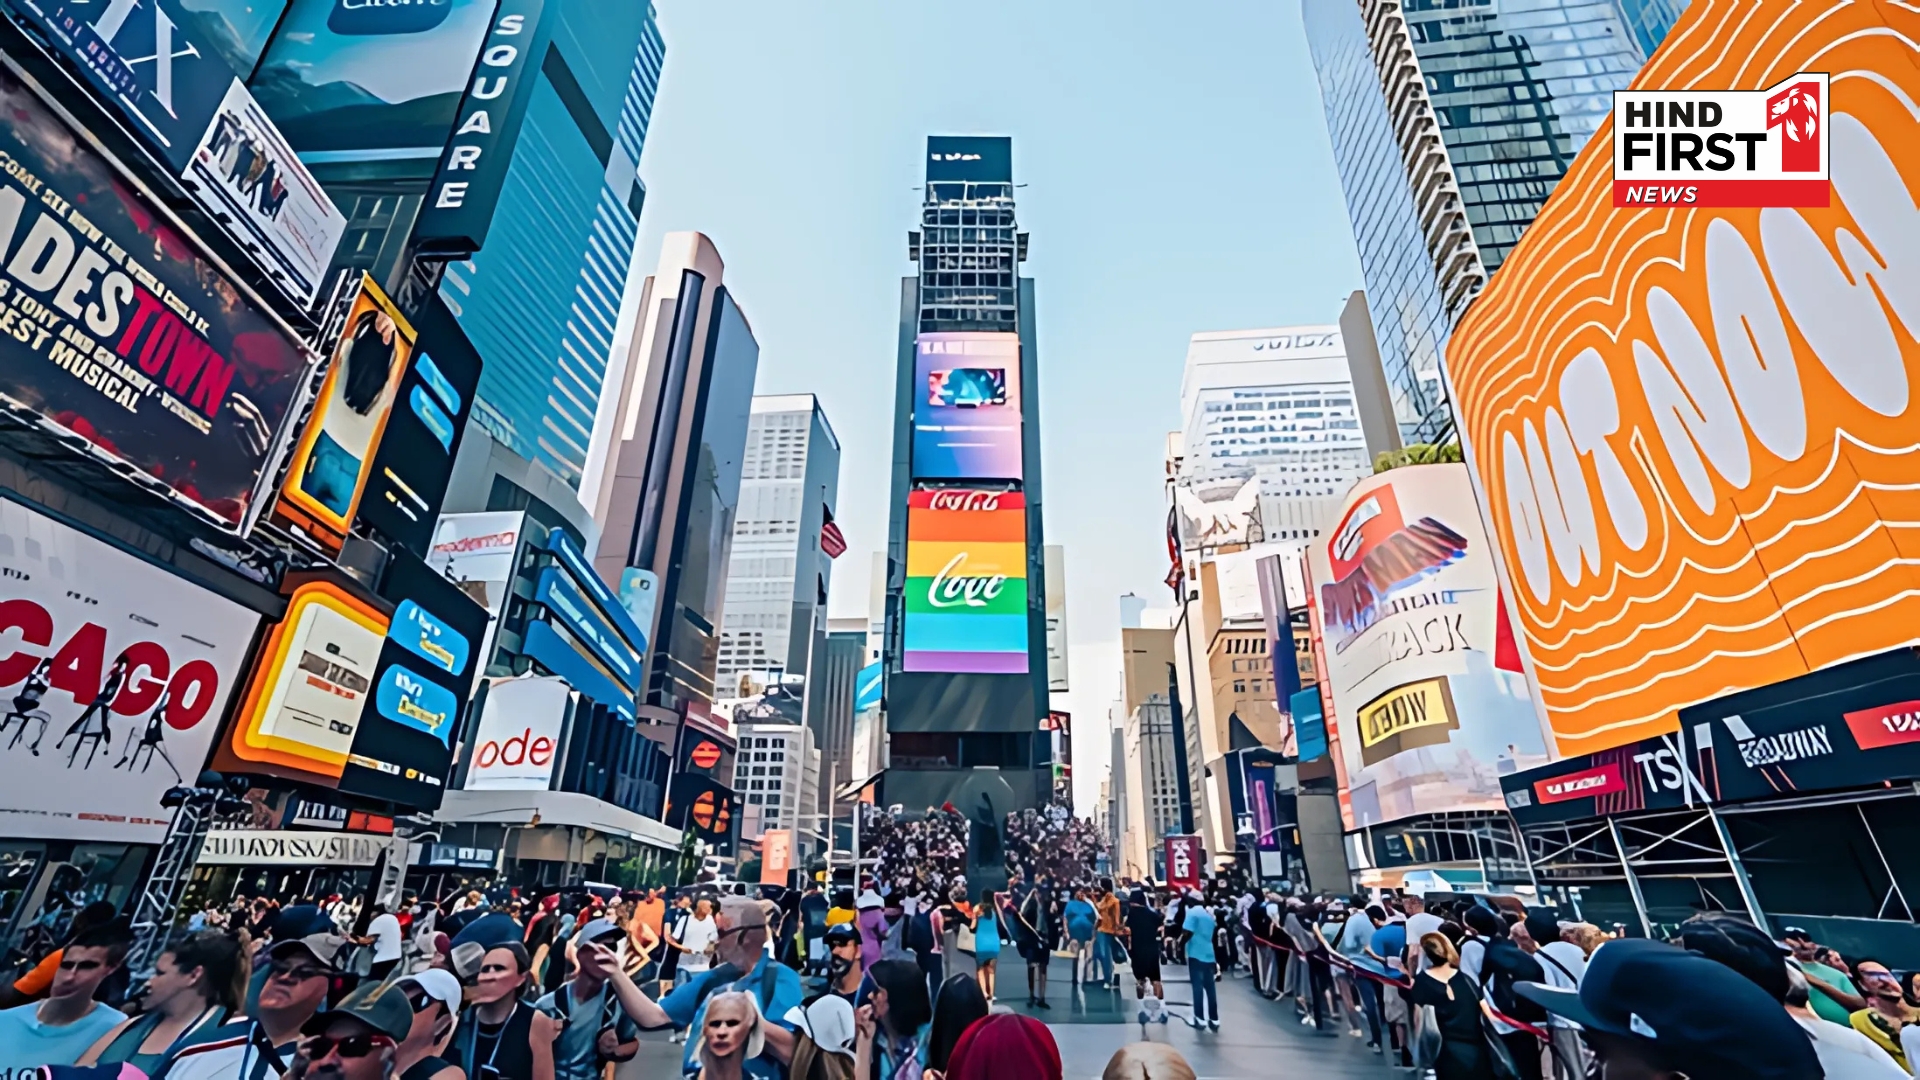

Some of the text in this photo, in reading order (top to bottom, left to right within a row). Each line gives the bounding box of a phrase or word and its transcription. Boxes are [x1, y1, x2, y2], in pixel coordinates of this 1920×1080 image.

[435, 14, 525, 208] SQUARE
[49, 339, 137, 413] MUSICAL
[1503, 346, 1648, 607] OUT
[1633, 731, 1712, 812] TSX
